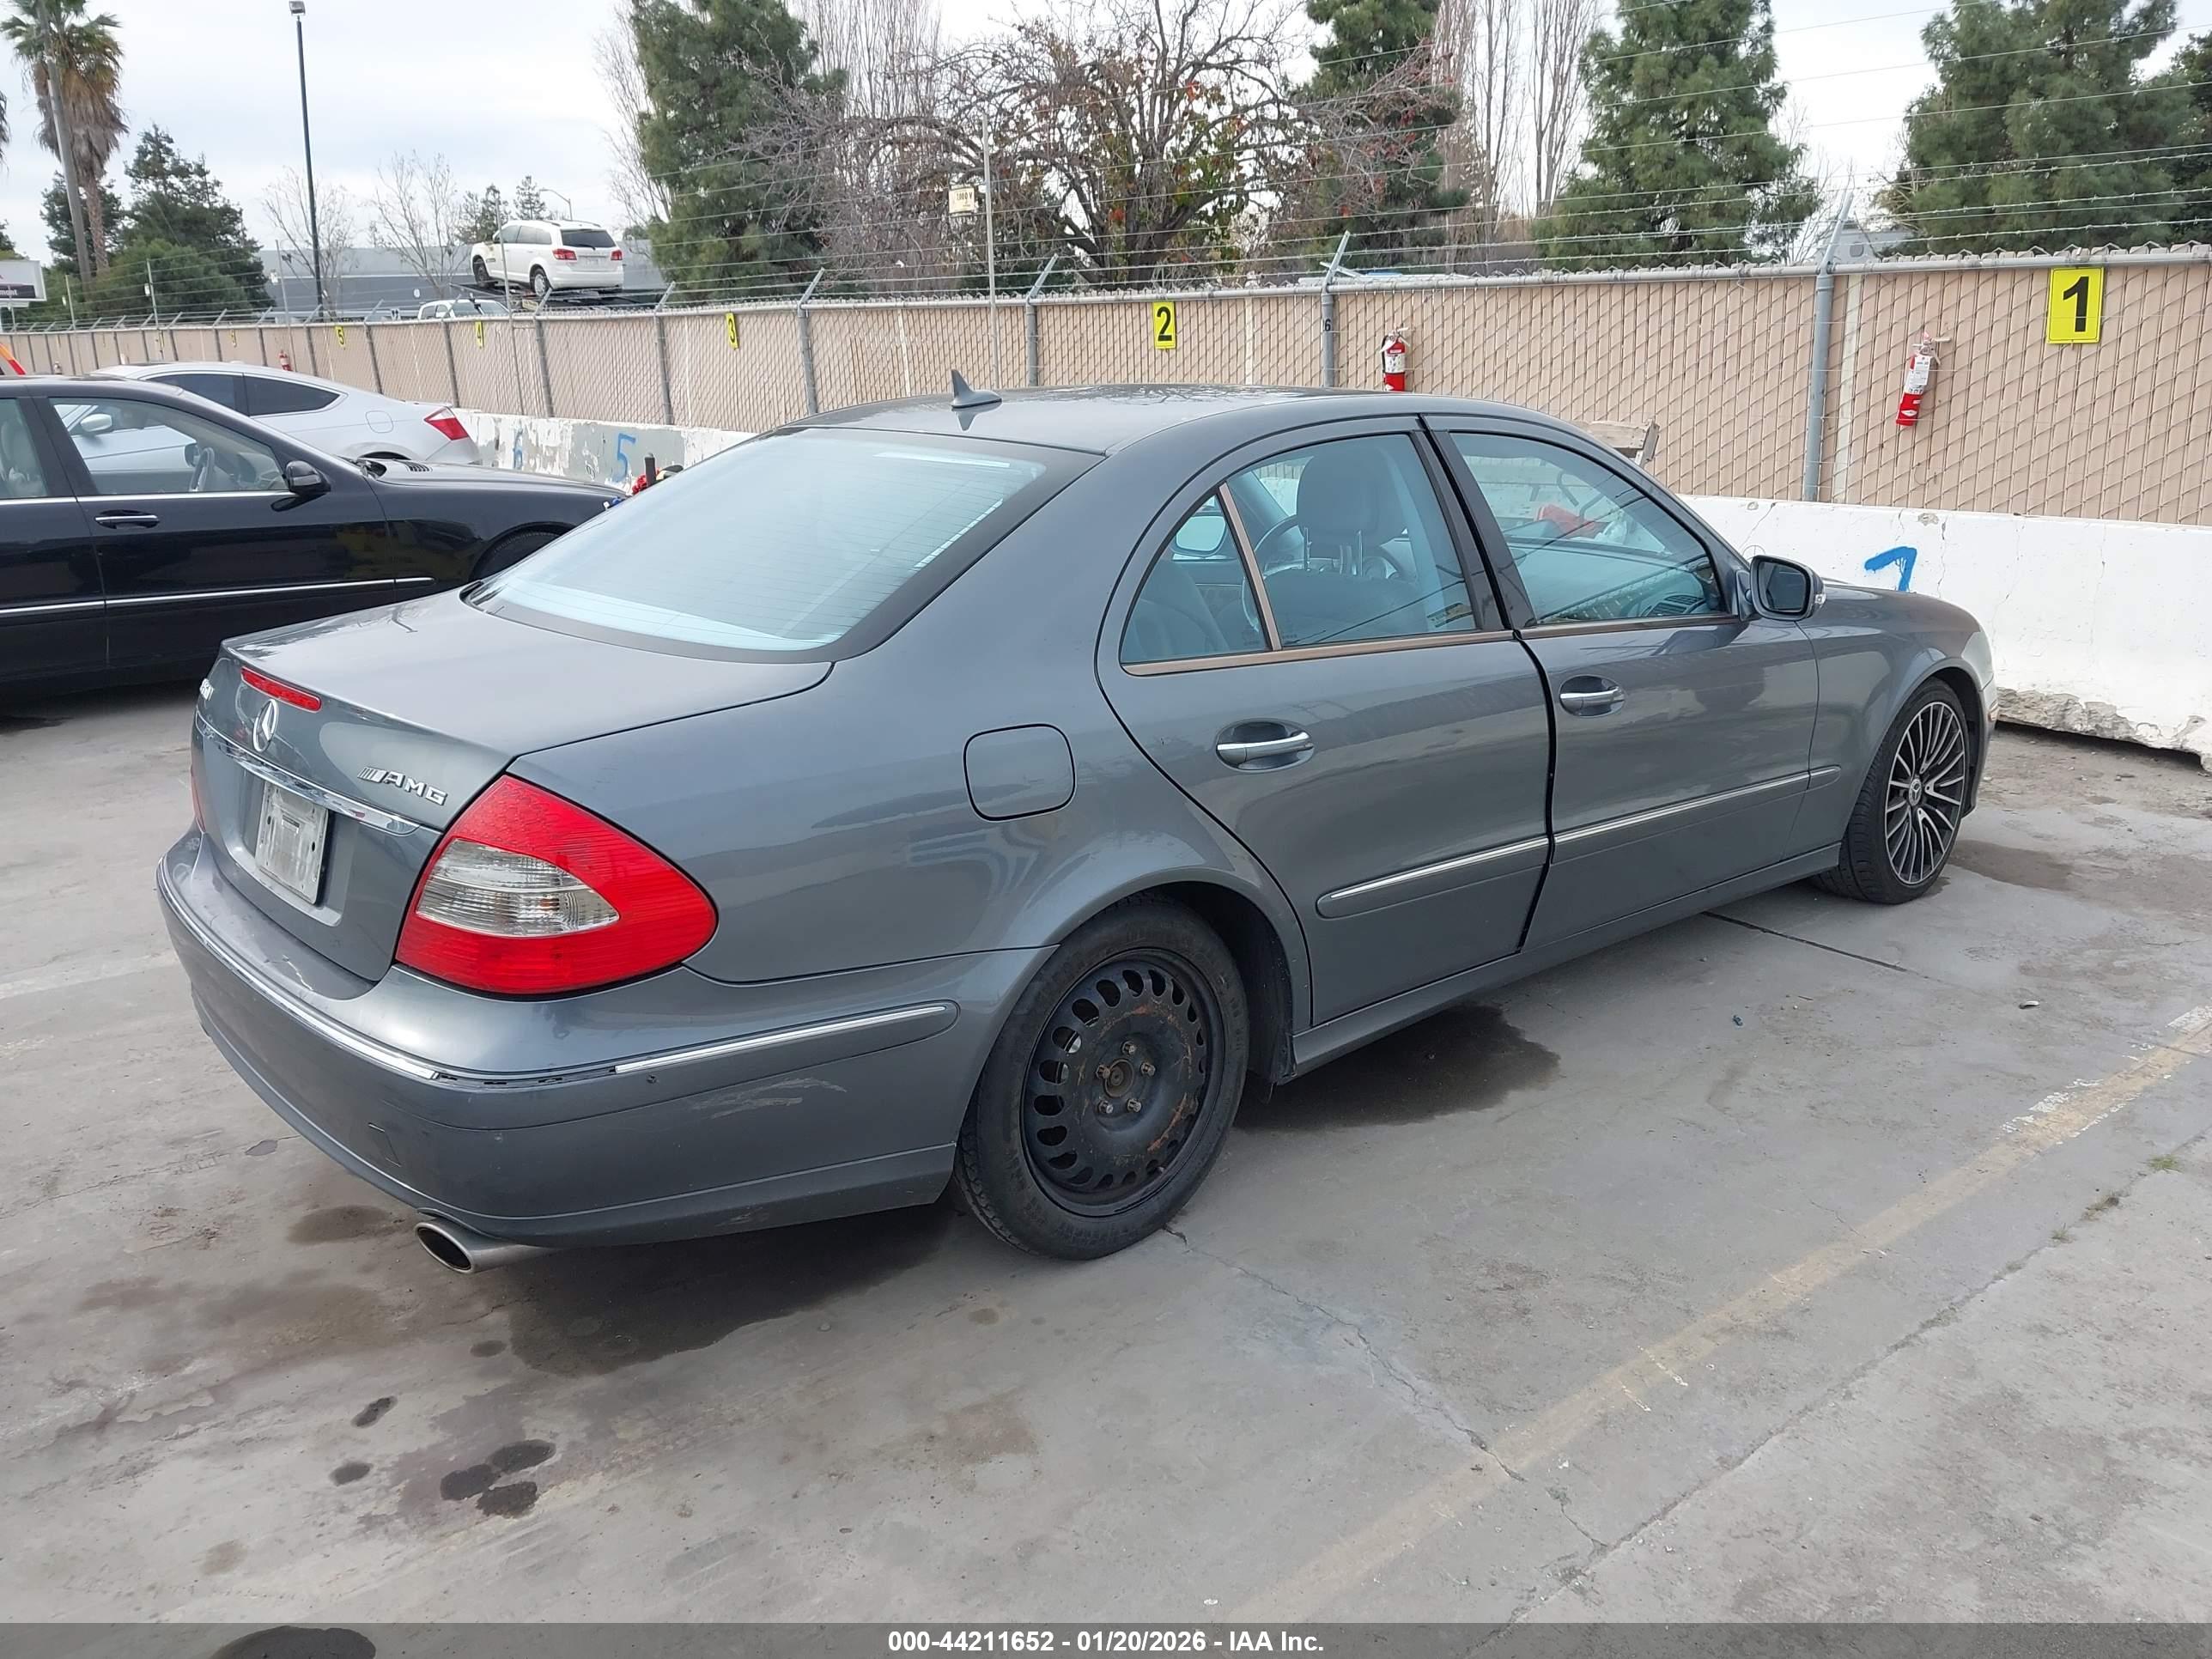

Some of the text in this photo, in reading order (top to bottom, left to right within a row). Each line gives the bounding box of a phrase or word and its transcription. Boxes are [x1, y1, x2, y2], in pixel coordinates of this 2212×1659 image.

[2062, 276, 2089, 332] 1
[337, 329, 344, 345] 5
[728, 318, 736, 343] 3
[1157, 306, 1173, 342] 2
[616, 433, 636, 483] 5
[383, 770, 448, 806] AMG
